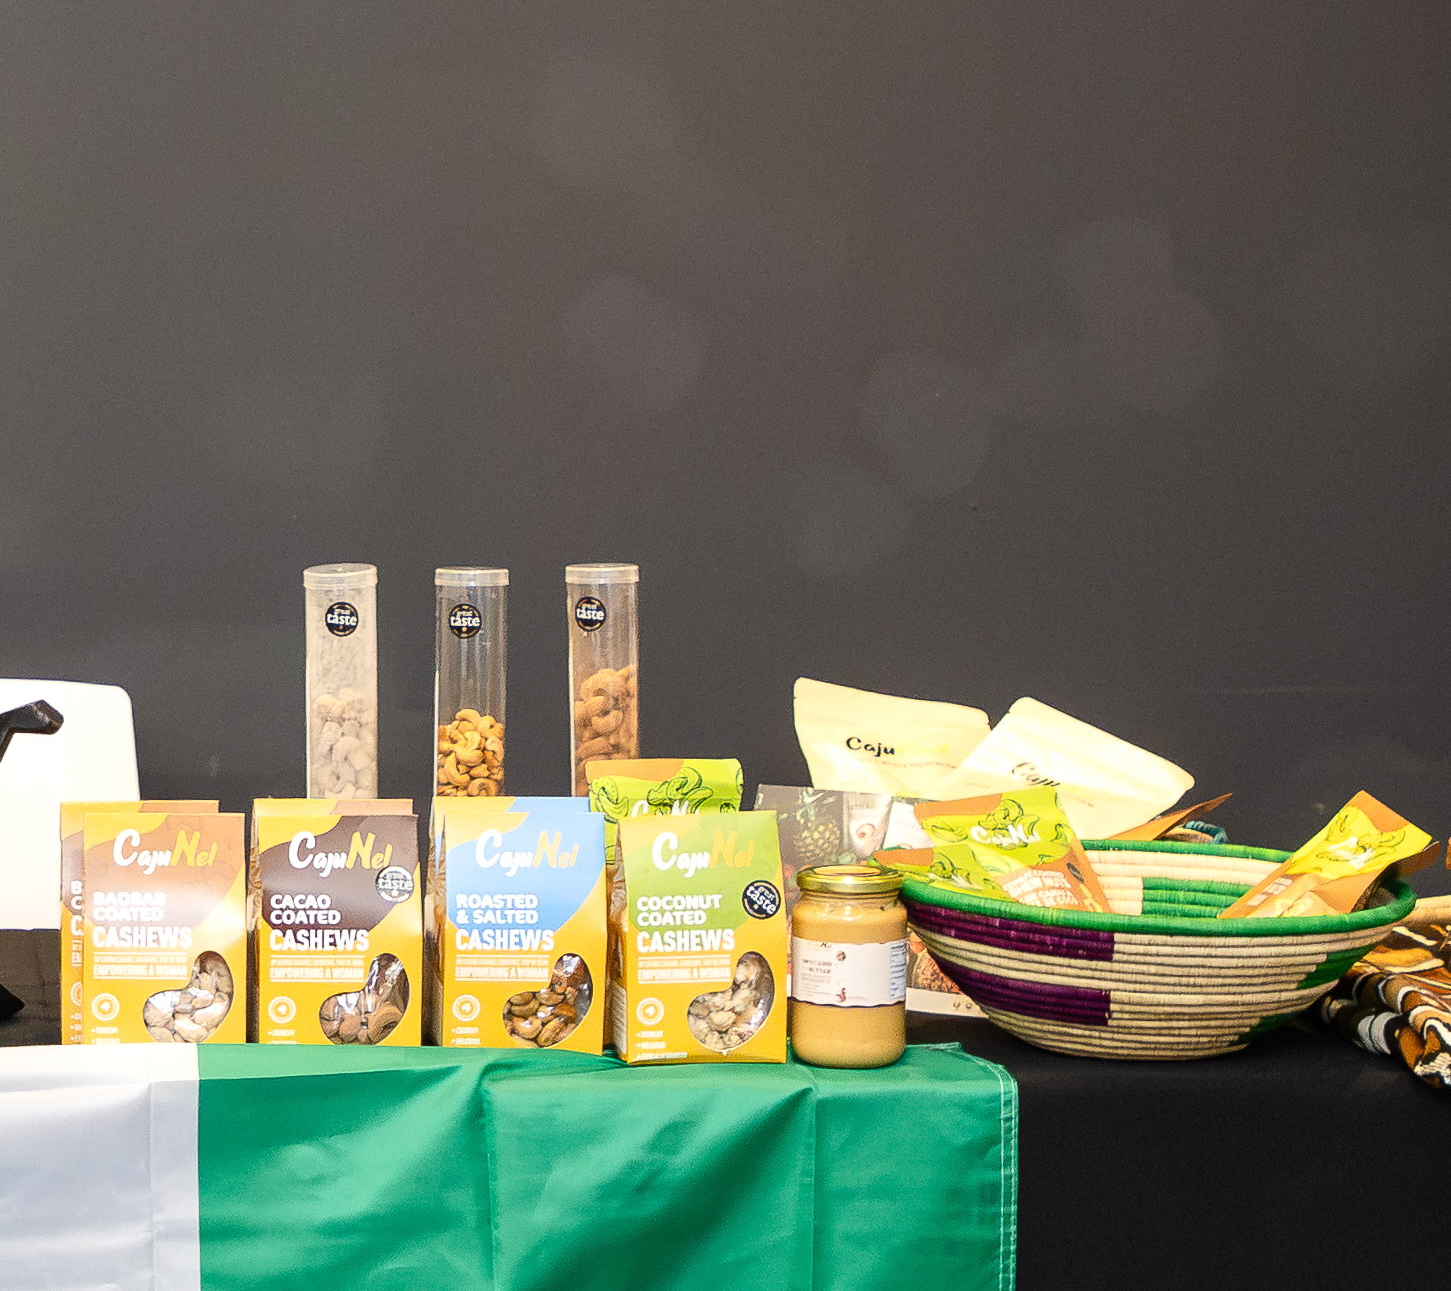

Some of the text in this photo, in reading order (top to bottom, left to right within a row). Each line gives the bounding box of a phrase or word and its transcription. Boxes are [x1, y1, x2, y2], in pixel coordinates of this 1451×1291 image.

[326, 612, 358, 626] taste
[450, 615, 480, 628] taste
[576, 607, 605, 621] taste
[113, 828, 219, 876] CajuNel
[288, 831, 392, 878] CajuNel
[475, 830, 578, 878] CajuNel
[652, 831, 754, 878] CajuNel
[377, 878, 413, 891] taste
[270, 894, 331, 909] CACAO
[456, 894, 538, 910] ROASTED
[637, 894, 721, 910] COCONUT
[746, 884, 779, 916] taste
[93, 908, 164, 922] COATED
[270, 909, 341, 925] COATED
[456, 910, 538, 926] & SALTED
[637, 910, 706, 926] COATED
[93, 926, 192, 948] CASHEWS
[270, 929, 369, 951] CASHEWS
[455, 929, 555, 952] CASHEWS
[637, 929, 735, 952] CASHEWS
